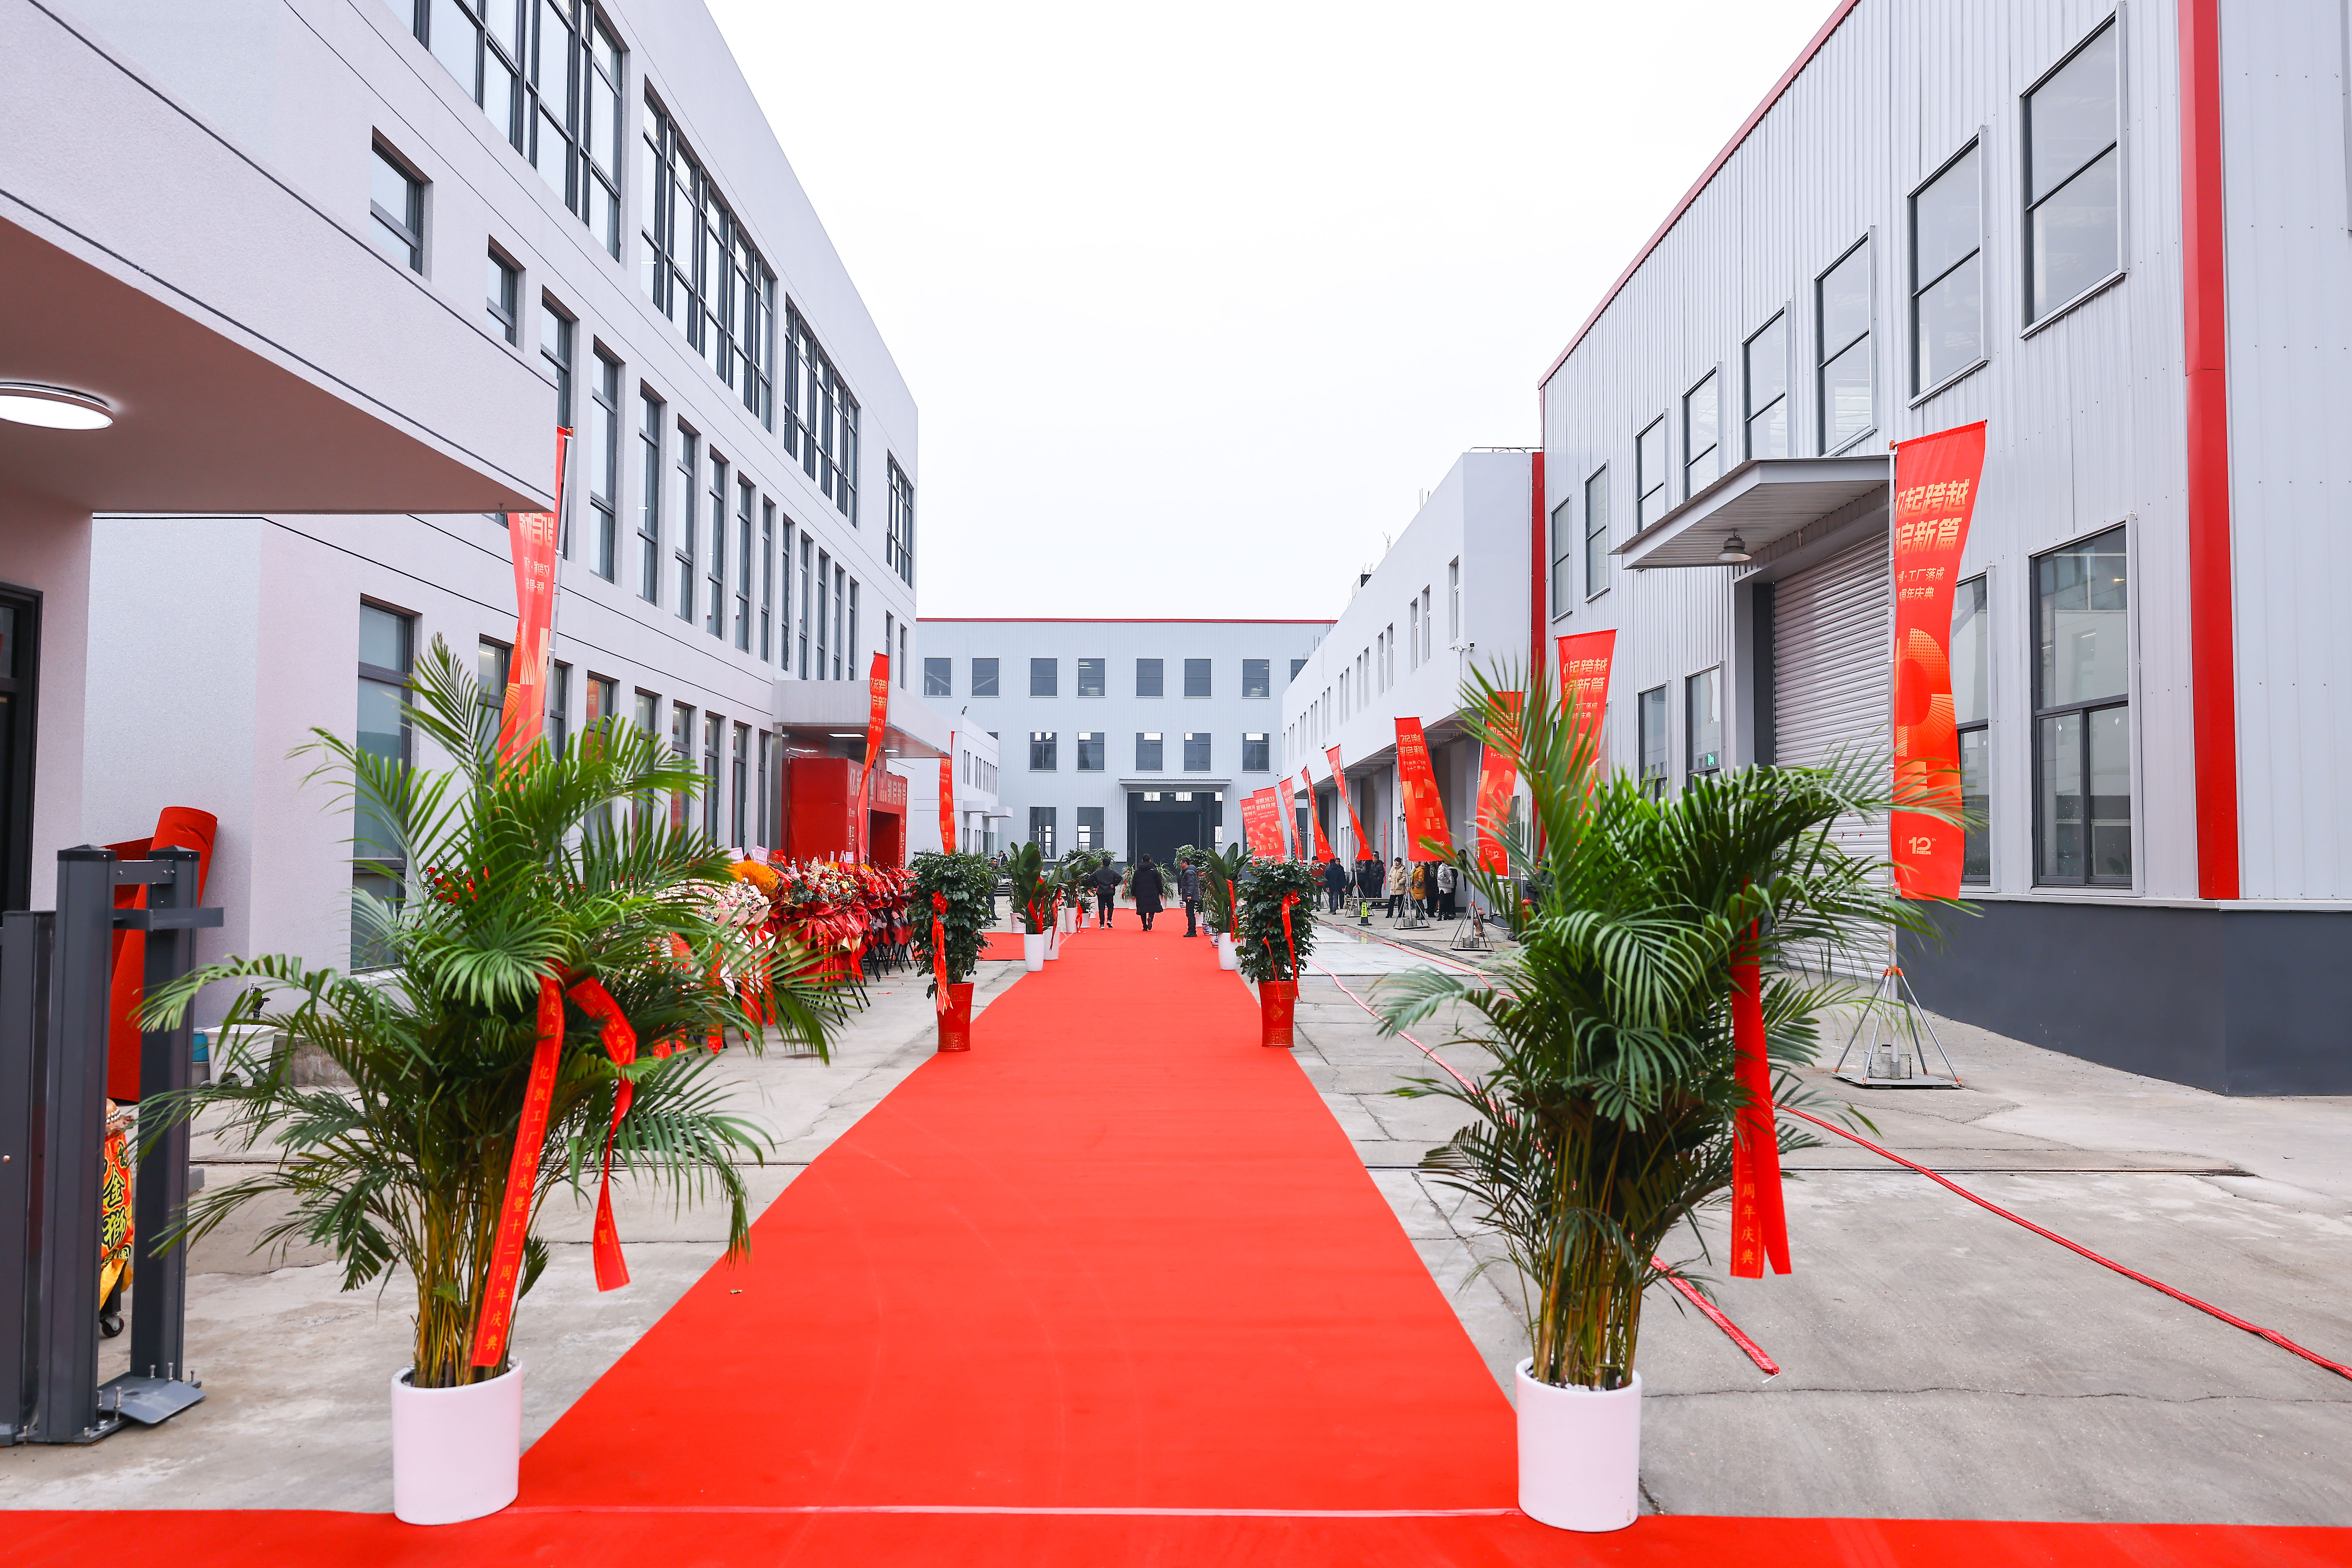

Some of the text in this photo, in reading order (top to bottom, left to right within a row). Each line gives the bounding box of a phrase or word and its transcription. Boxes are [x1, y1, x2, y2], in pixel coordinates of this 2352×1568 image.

[1899, 586, 1934, 603] 周年庆典
[486, 1066, 549, 1351] 亿凯工厂落成暨十二周年庆典
